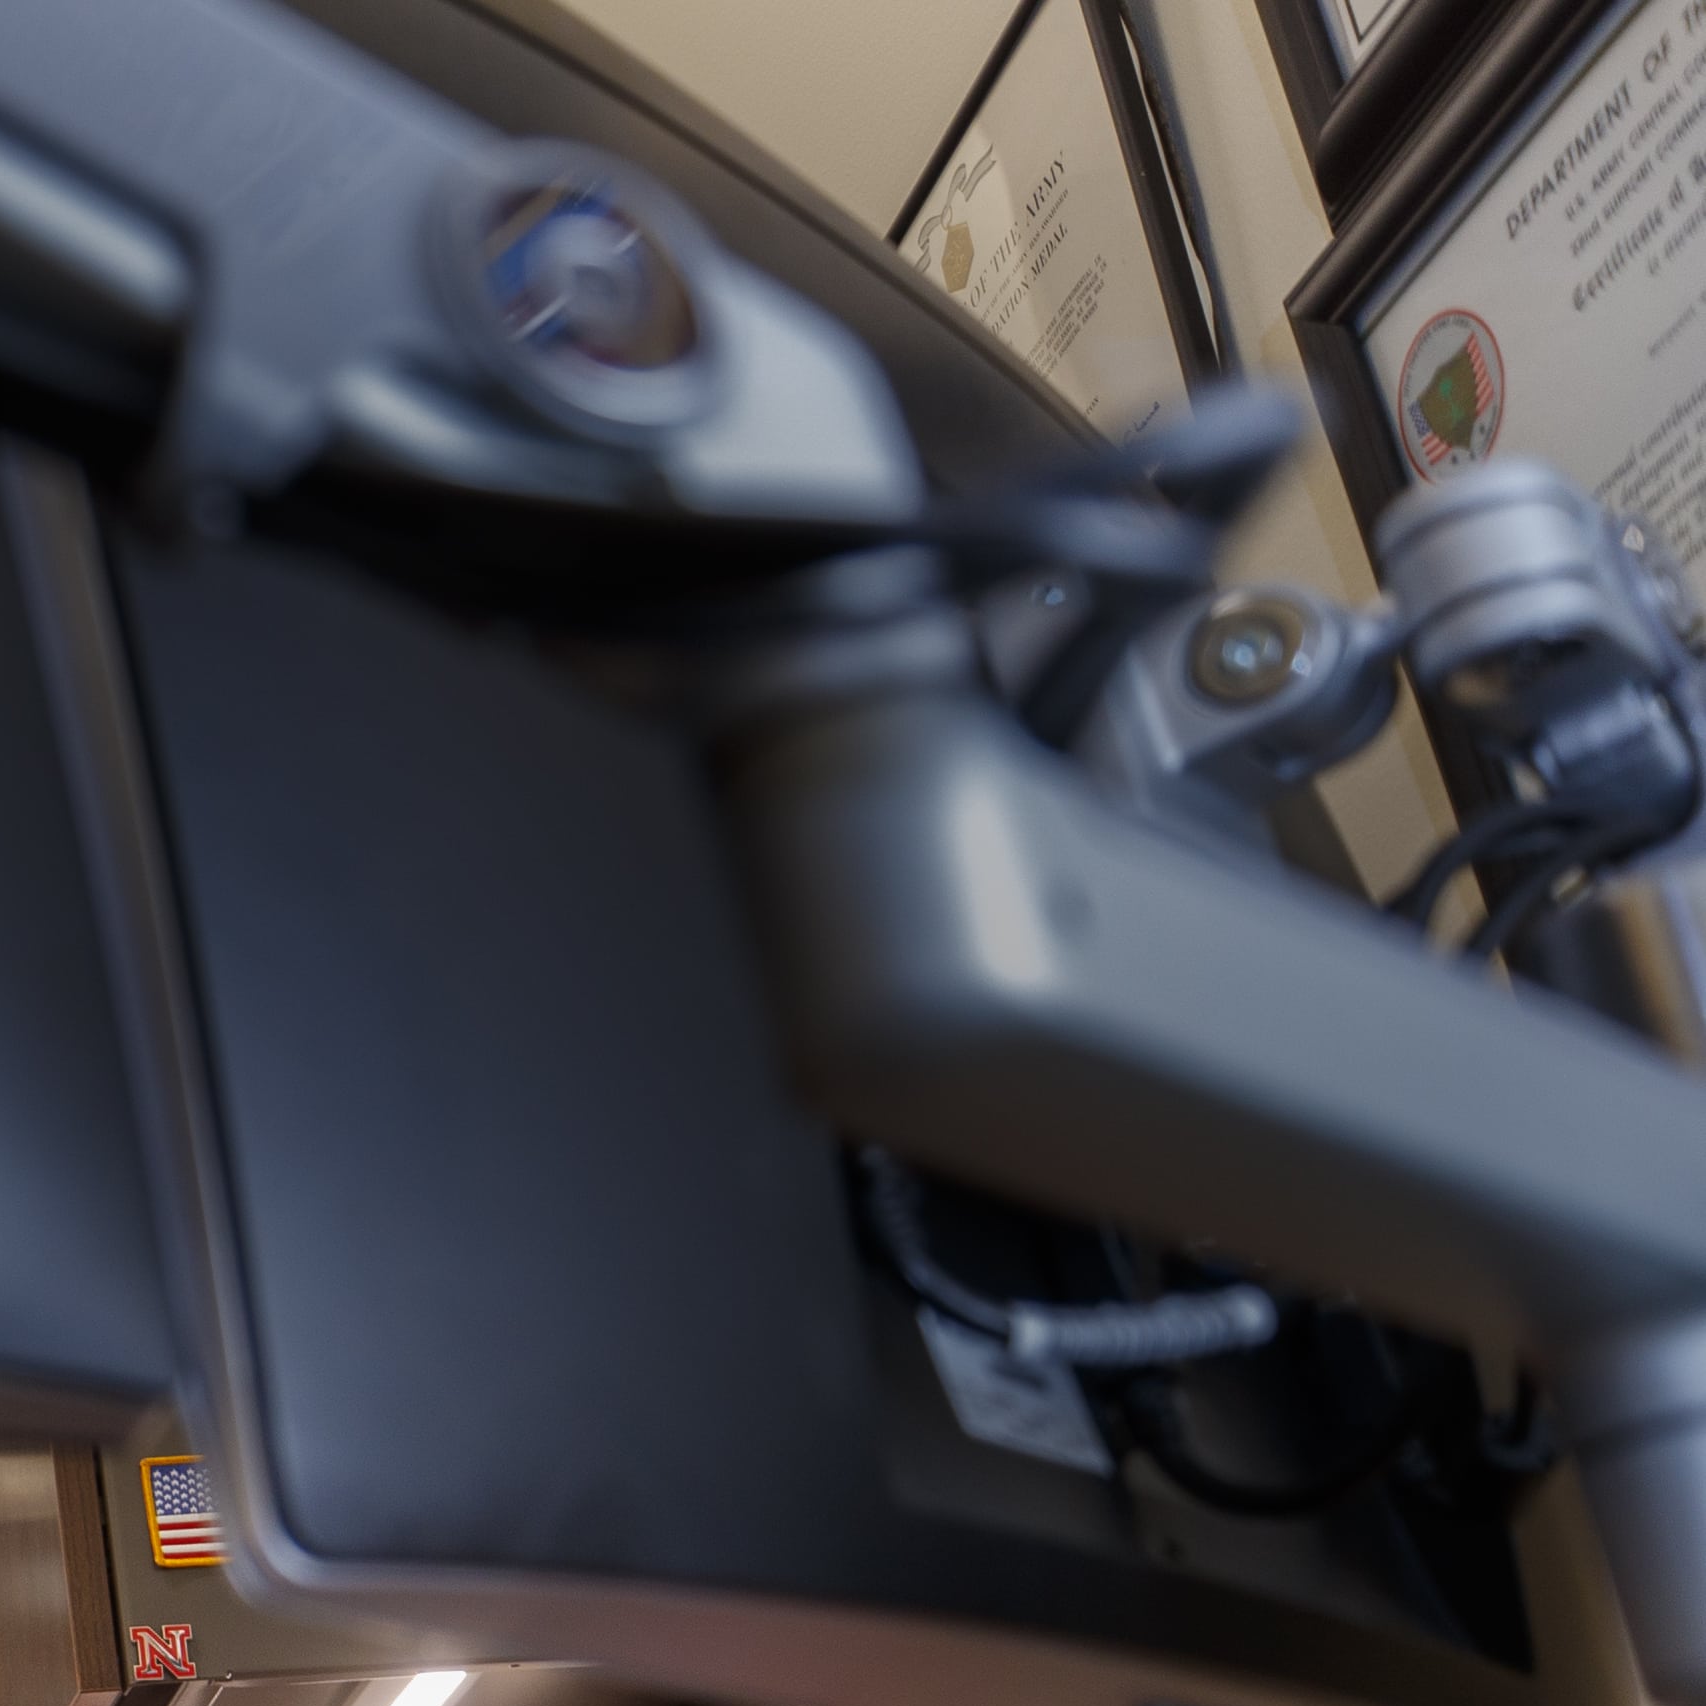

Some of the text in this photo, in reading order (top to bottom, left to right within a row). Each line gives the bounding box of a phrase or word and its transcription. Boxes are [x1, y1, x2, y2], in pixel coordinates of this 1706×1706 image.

[1505, 76, 1633, 241] DEPARTMENT
[1642, 28, 1673, 82] OF
[970, 150, 1066, 309] OF THE ARMY
[1030, 223, 1069, 281] MEDAL
[129, 1623, 198, 1681] N
